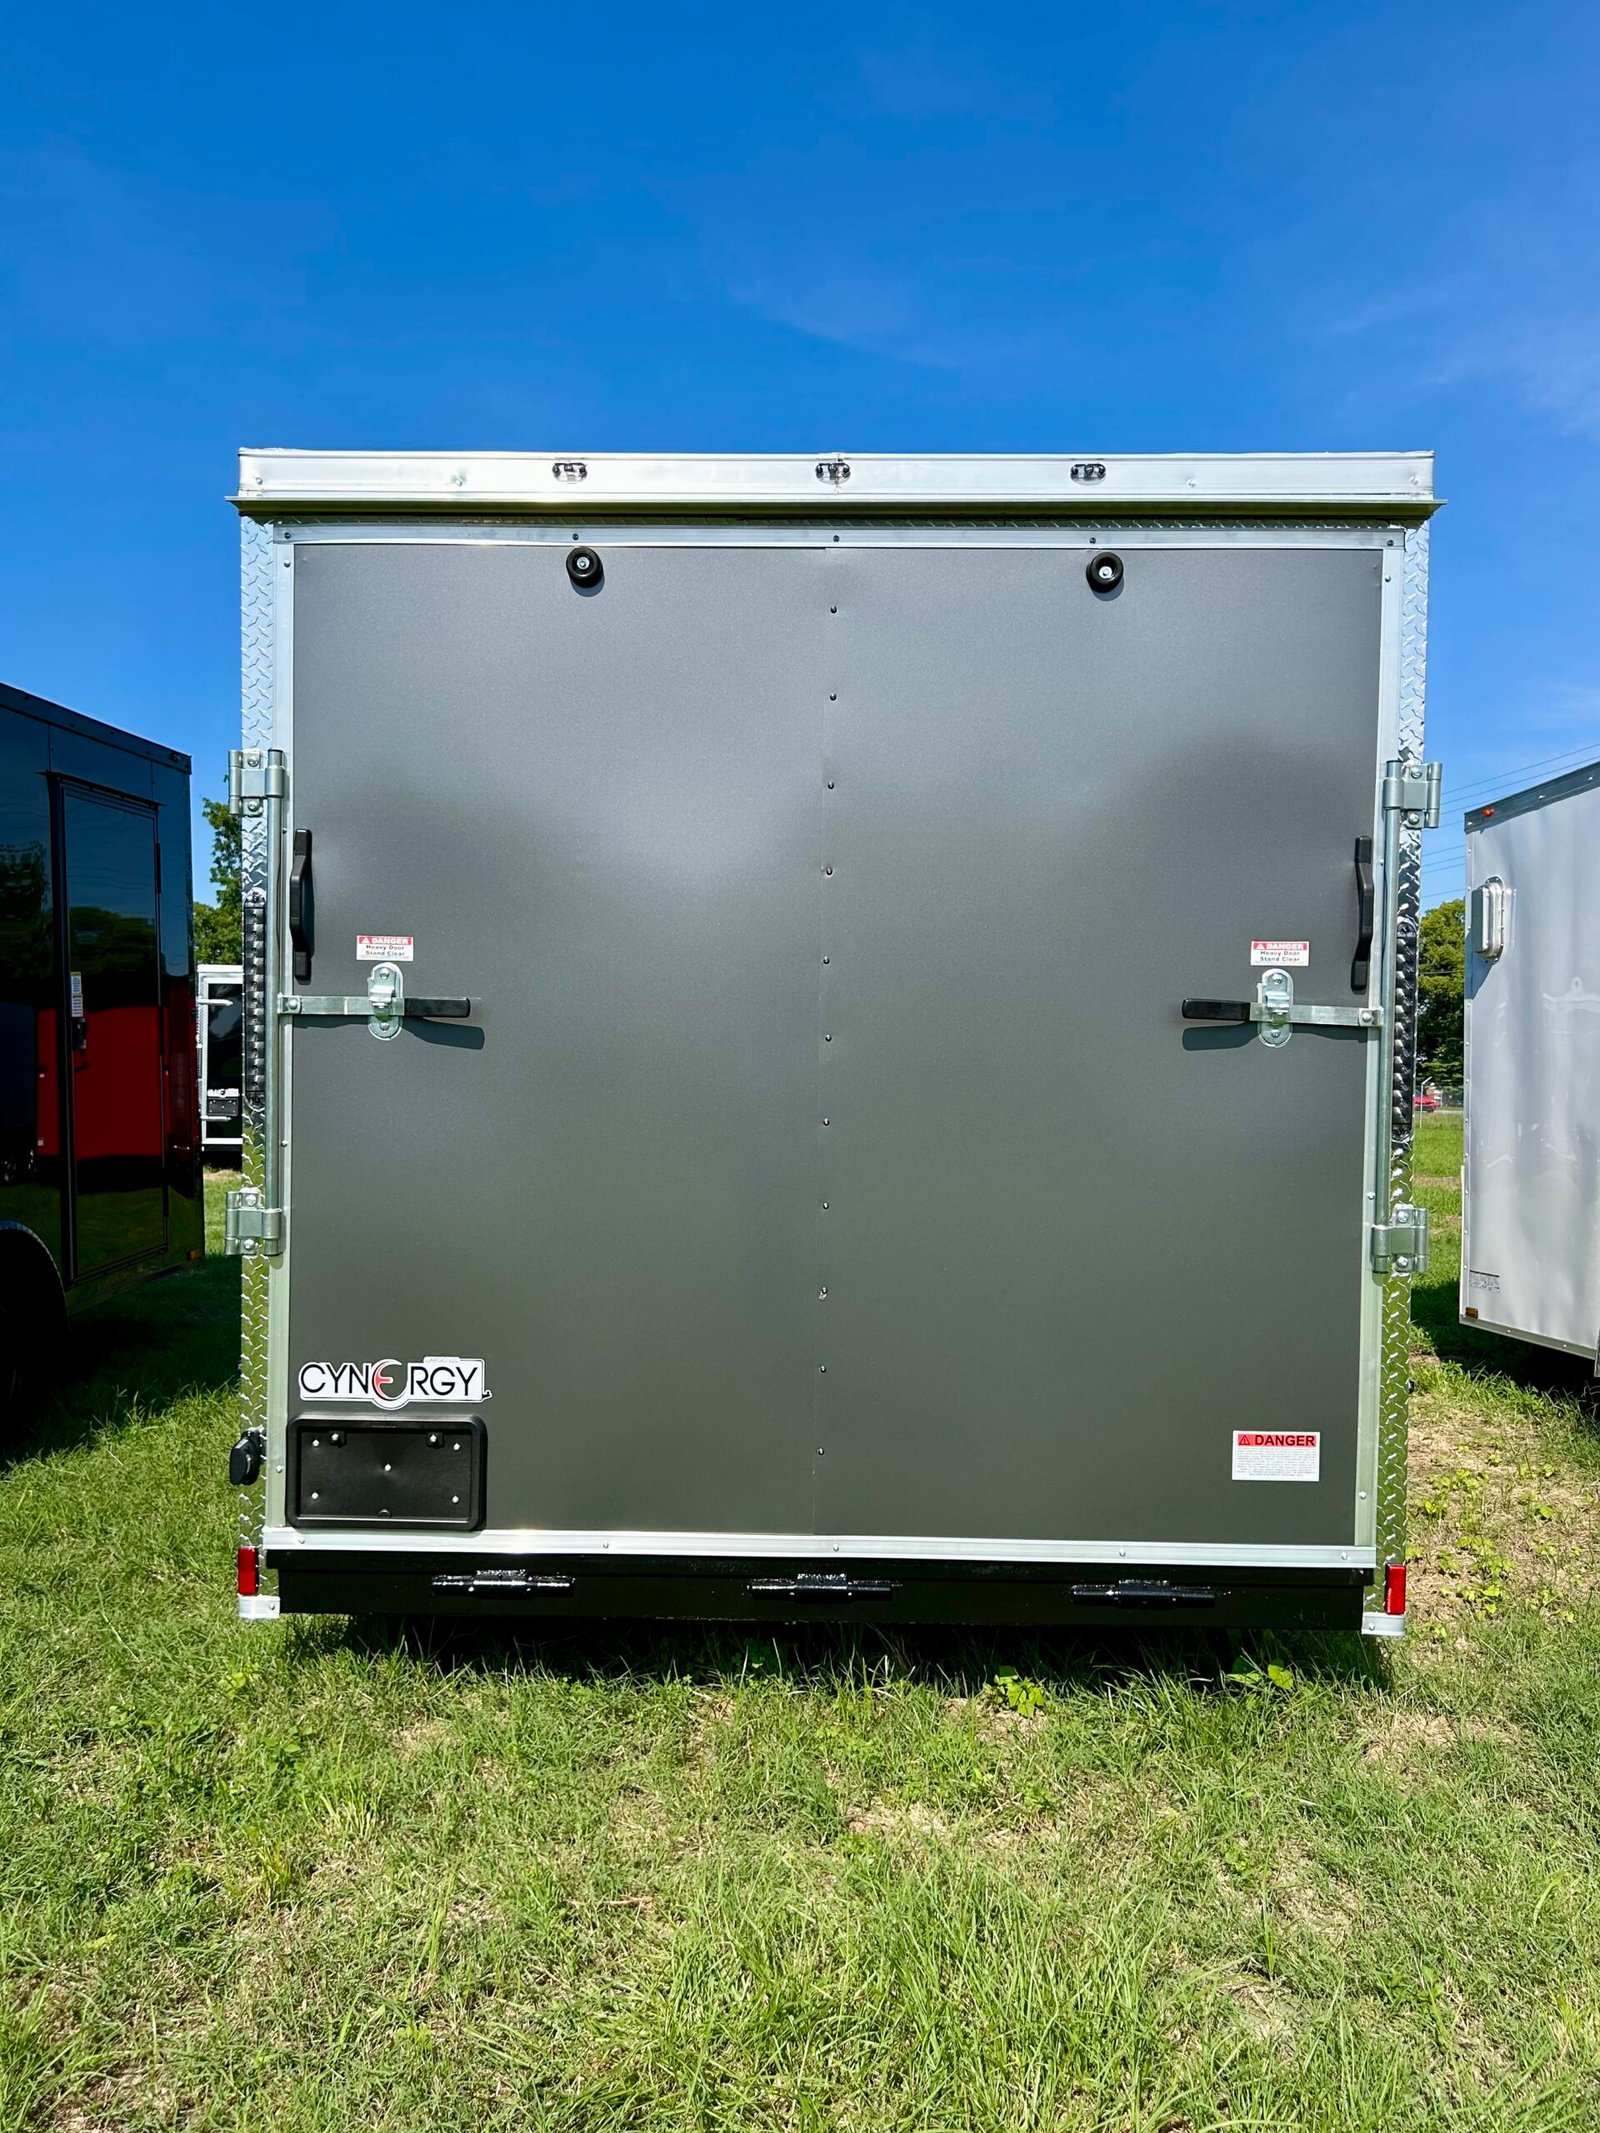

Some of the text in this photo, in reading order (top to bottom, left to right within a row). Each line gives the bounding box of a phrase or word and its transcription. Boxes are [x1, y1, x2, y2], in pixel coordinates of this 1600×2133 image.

[371, 936, 408, 945] DANGER
[1266, 942, 1304, 950] DANGER
[300, 1360, 478, 1401] CYNERGY
[1254, 1434, 1315, 1446] DANGER
